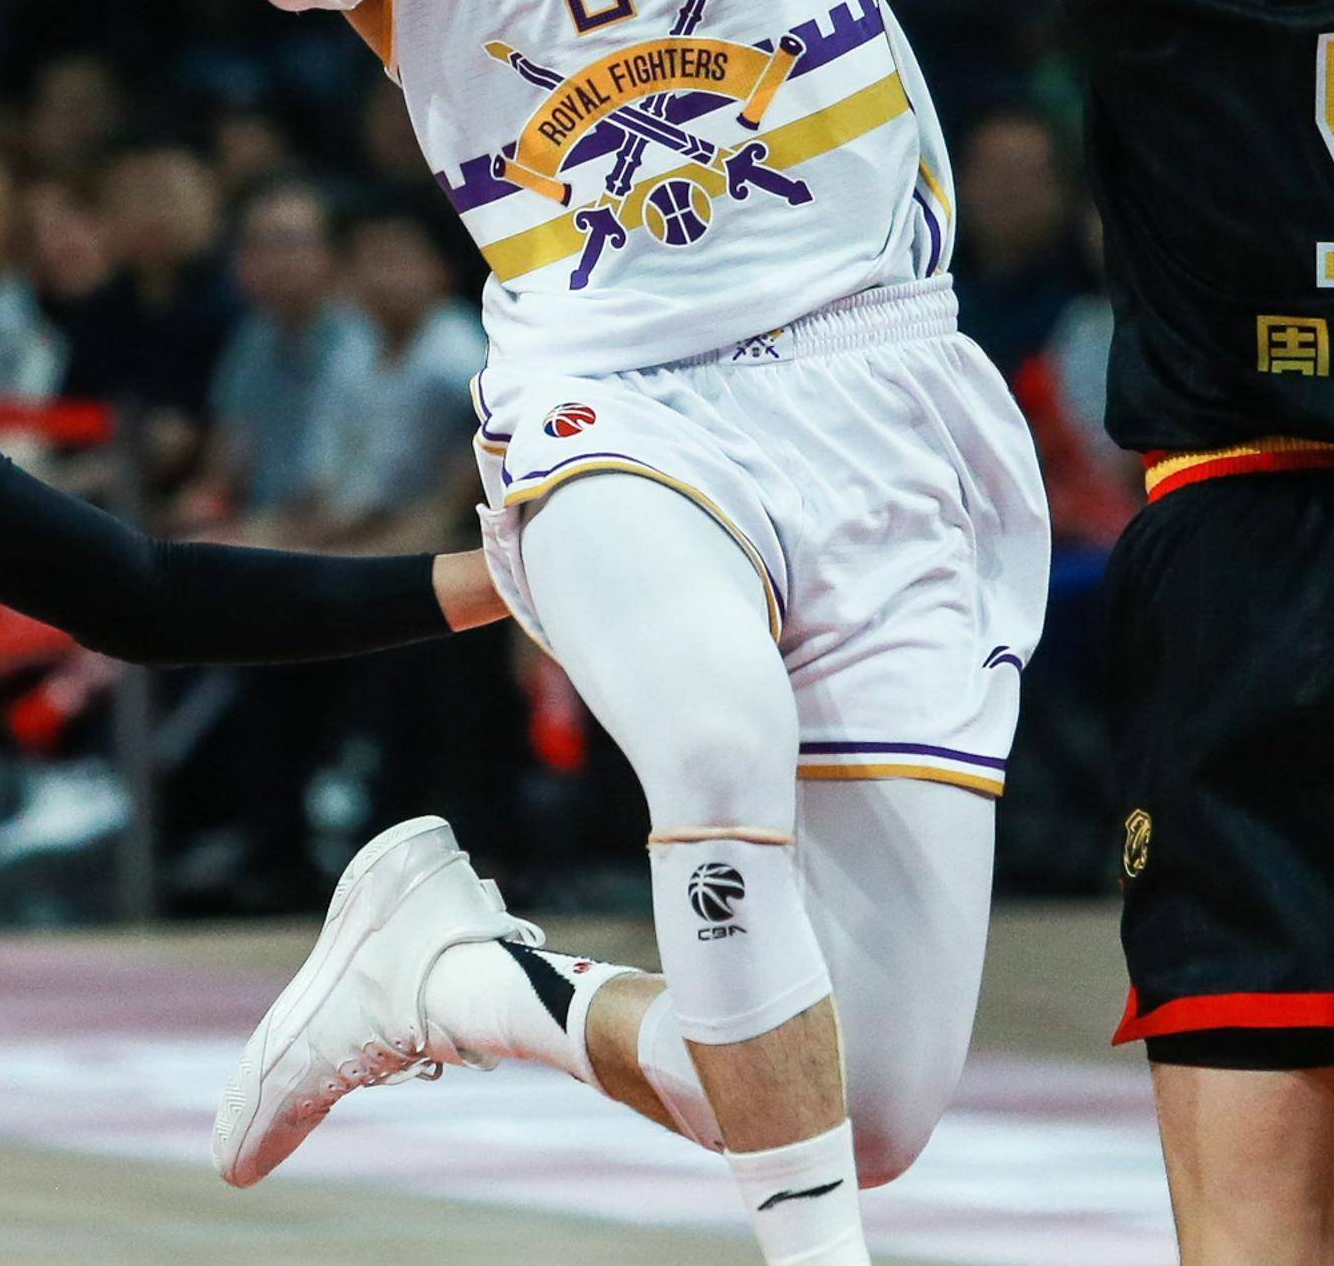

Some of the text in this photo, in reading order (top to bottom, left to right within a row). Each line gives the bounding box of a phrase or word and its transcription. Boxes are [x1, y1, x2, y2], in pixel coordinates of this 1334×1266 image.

[538, 48, 728, 146] ROYAL FIGHTERS
[1256, 314, 1329, 376] 周
[698, 925, 747, 941] CBA
